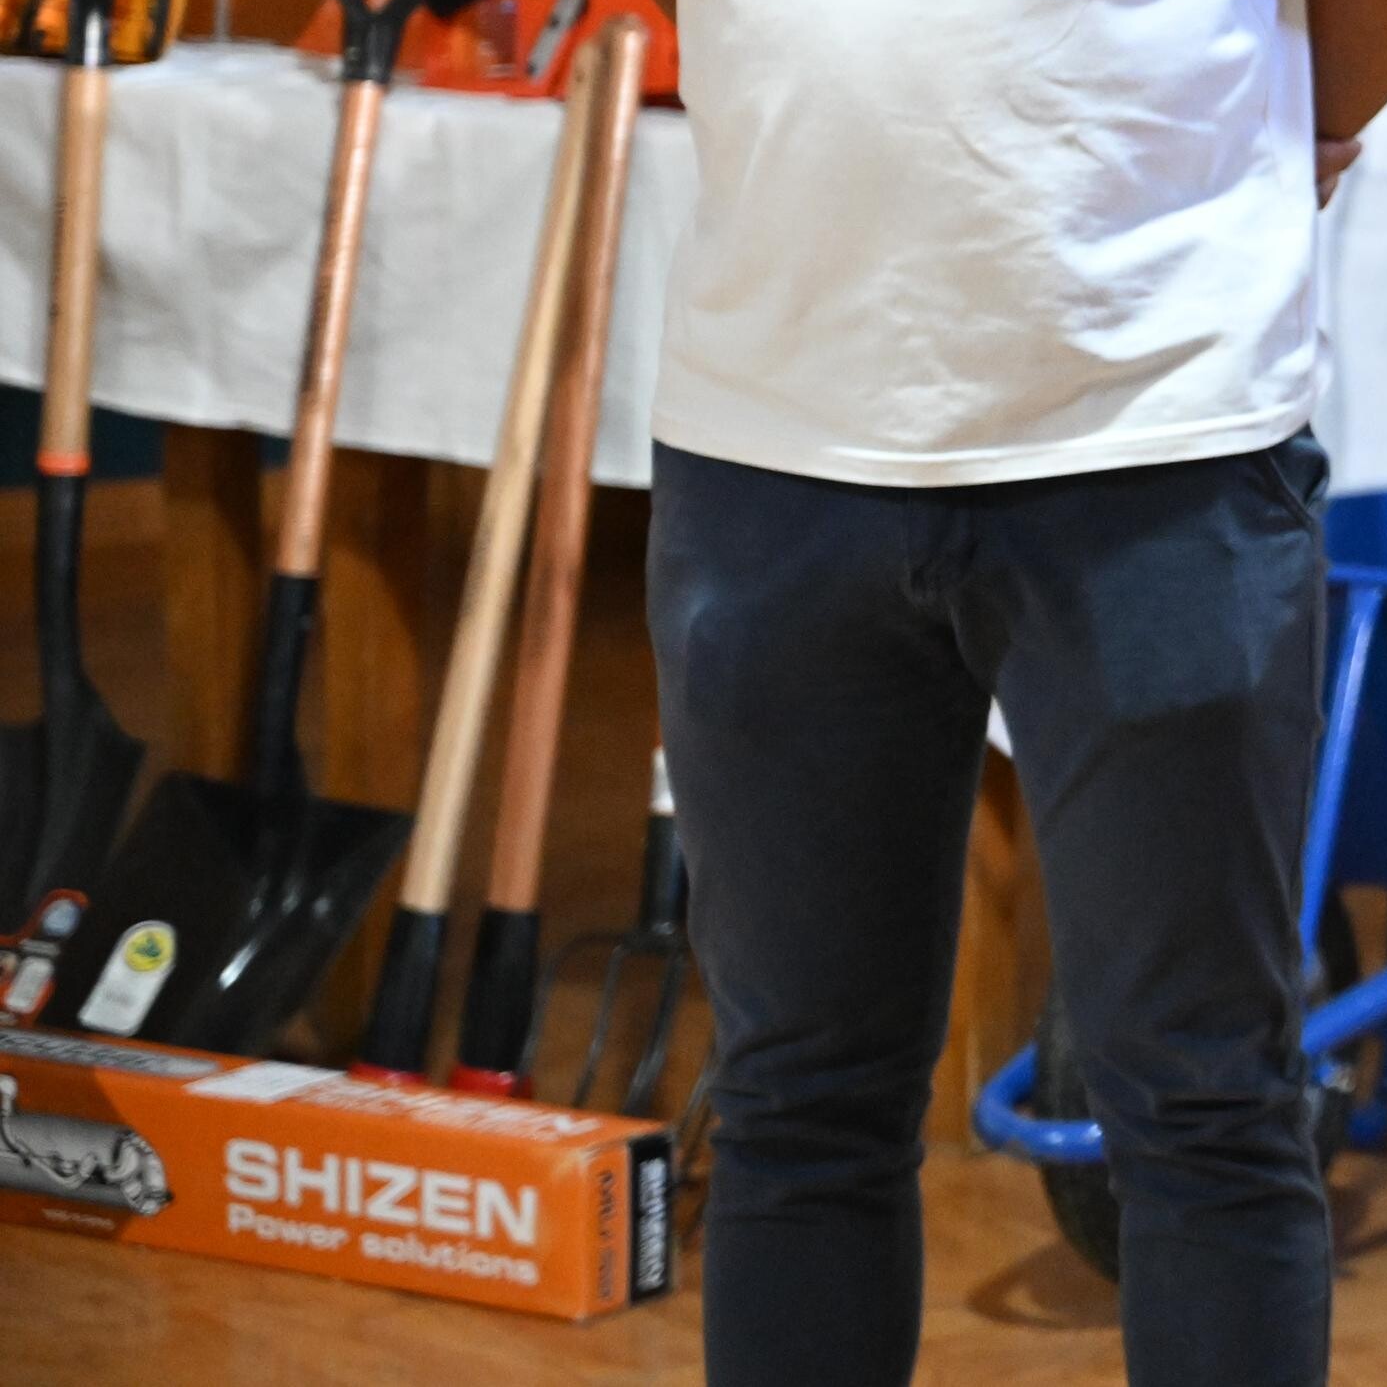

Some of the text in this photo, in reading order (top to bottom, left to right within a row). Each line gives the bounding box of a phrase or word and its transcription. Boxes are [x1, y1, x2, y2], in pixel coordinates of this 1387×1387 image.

[225, 1136, 539, 1246] SHIZEN
[227, 1201, 348, 1251] Power
[360, 1231, 540, 1287] solutions
